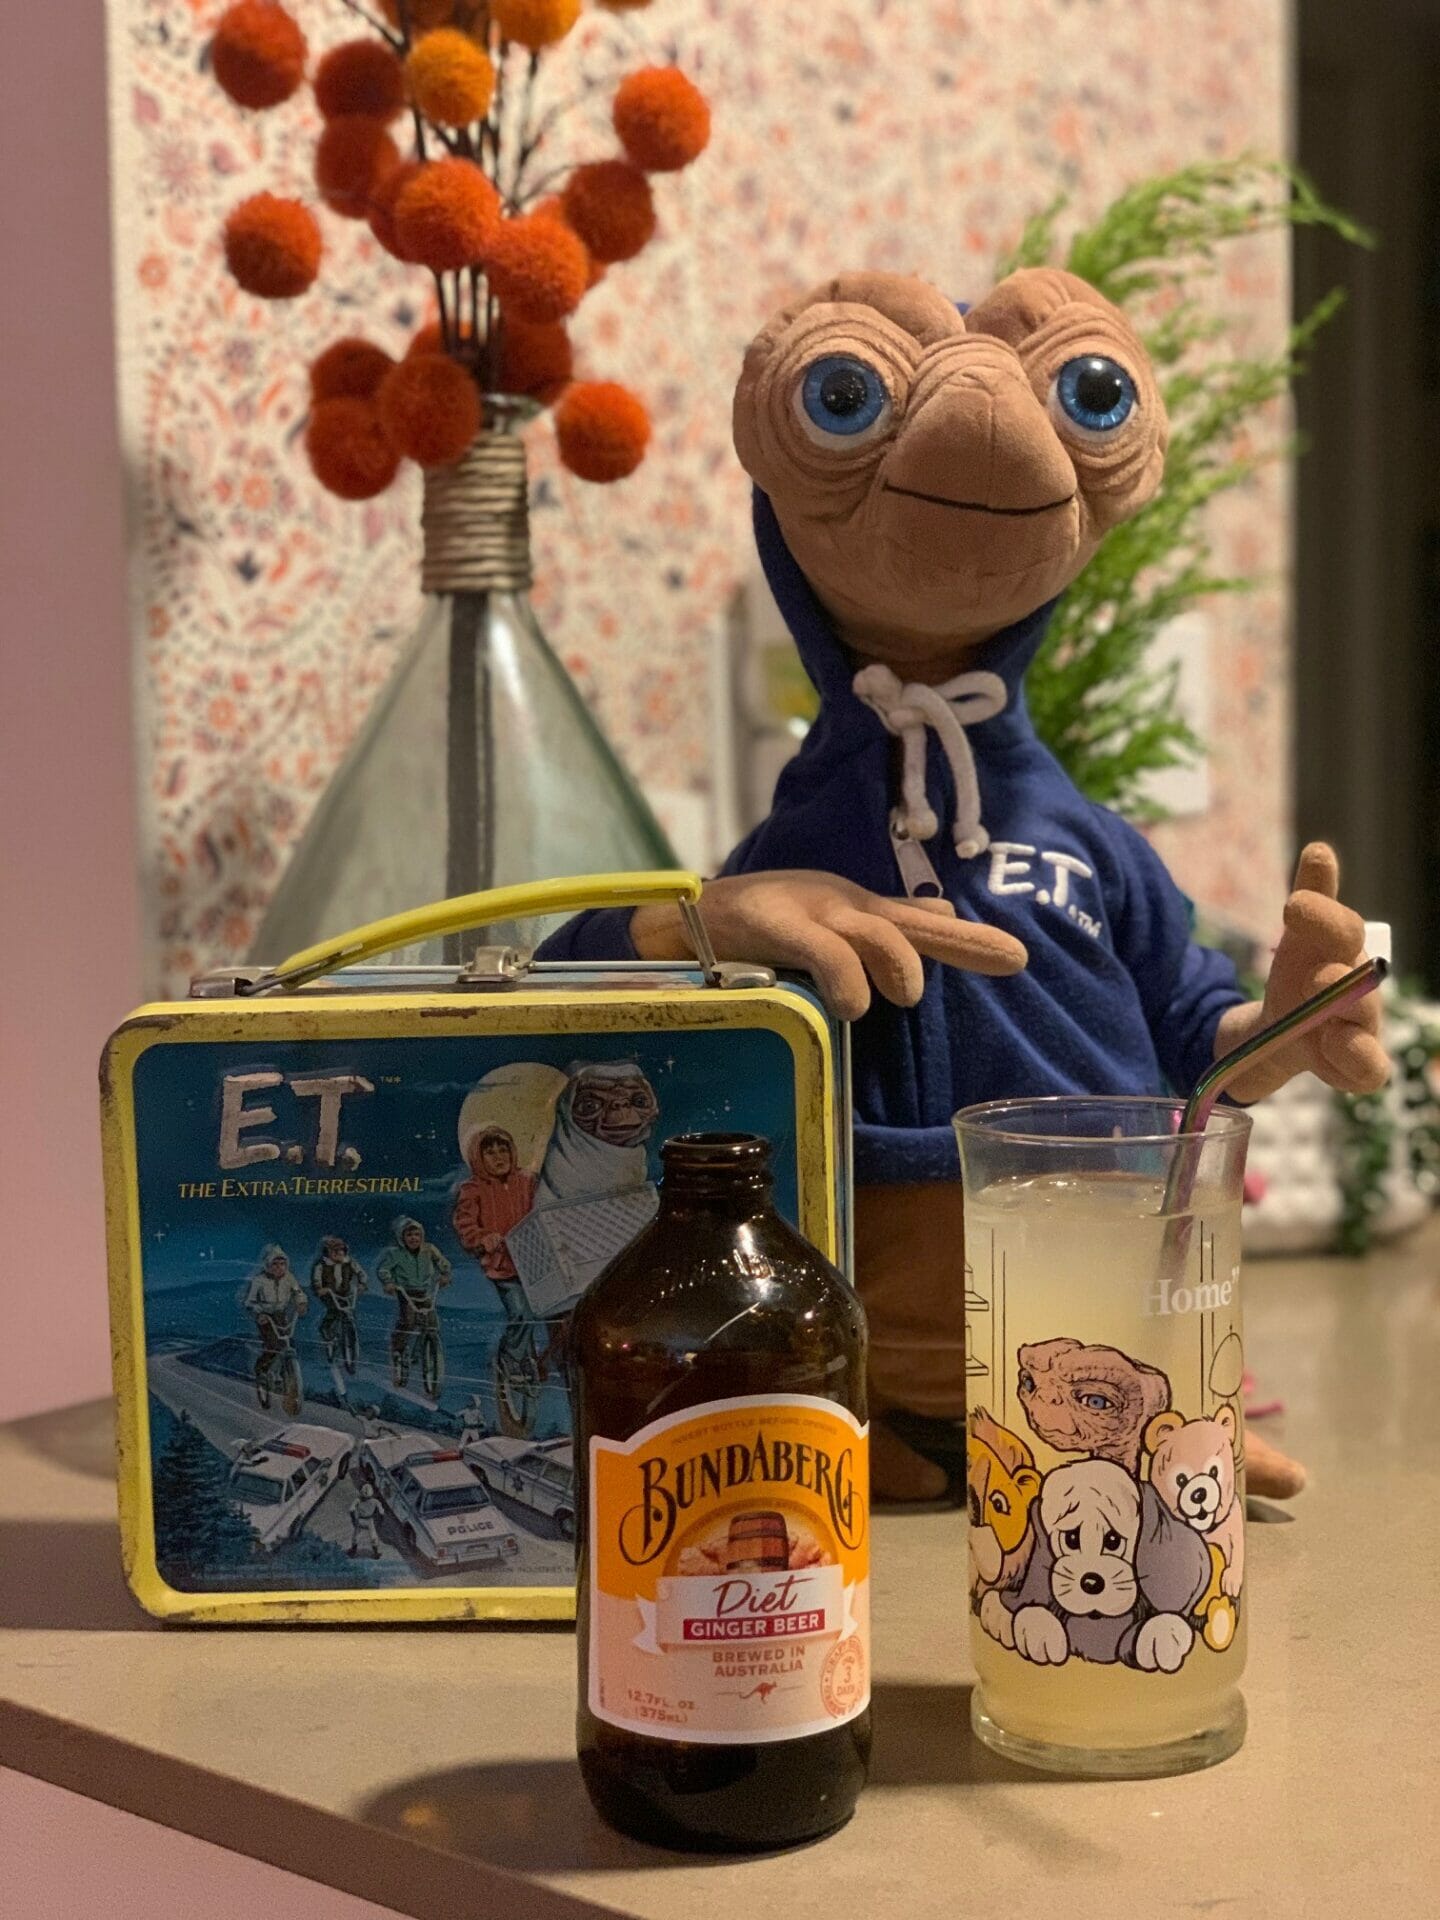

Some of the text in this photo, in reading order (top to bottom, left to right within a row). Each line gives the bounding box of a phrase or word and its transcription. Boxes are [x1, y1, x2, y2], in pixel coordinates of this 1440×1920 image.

[218, 1069, 376, 1172] E.T.
[178, 1176, 425, 1199] THE EXTRA-TERRESTRIAL
[618, 1430, 864, 1566] BUNDABERG
[447, 1520, 495, 1536] POLICE
[712, 1574, 816, 1618] Diet
[690, 1614, 820, 1638] GINGER BEER
[712, 1645, 806, 1663] BREWED IN
[714, 1660, 804, 1678] AUSTRALIA
